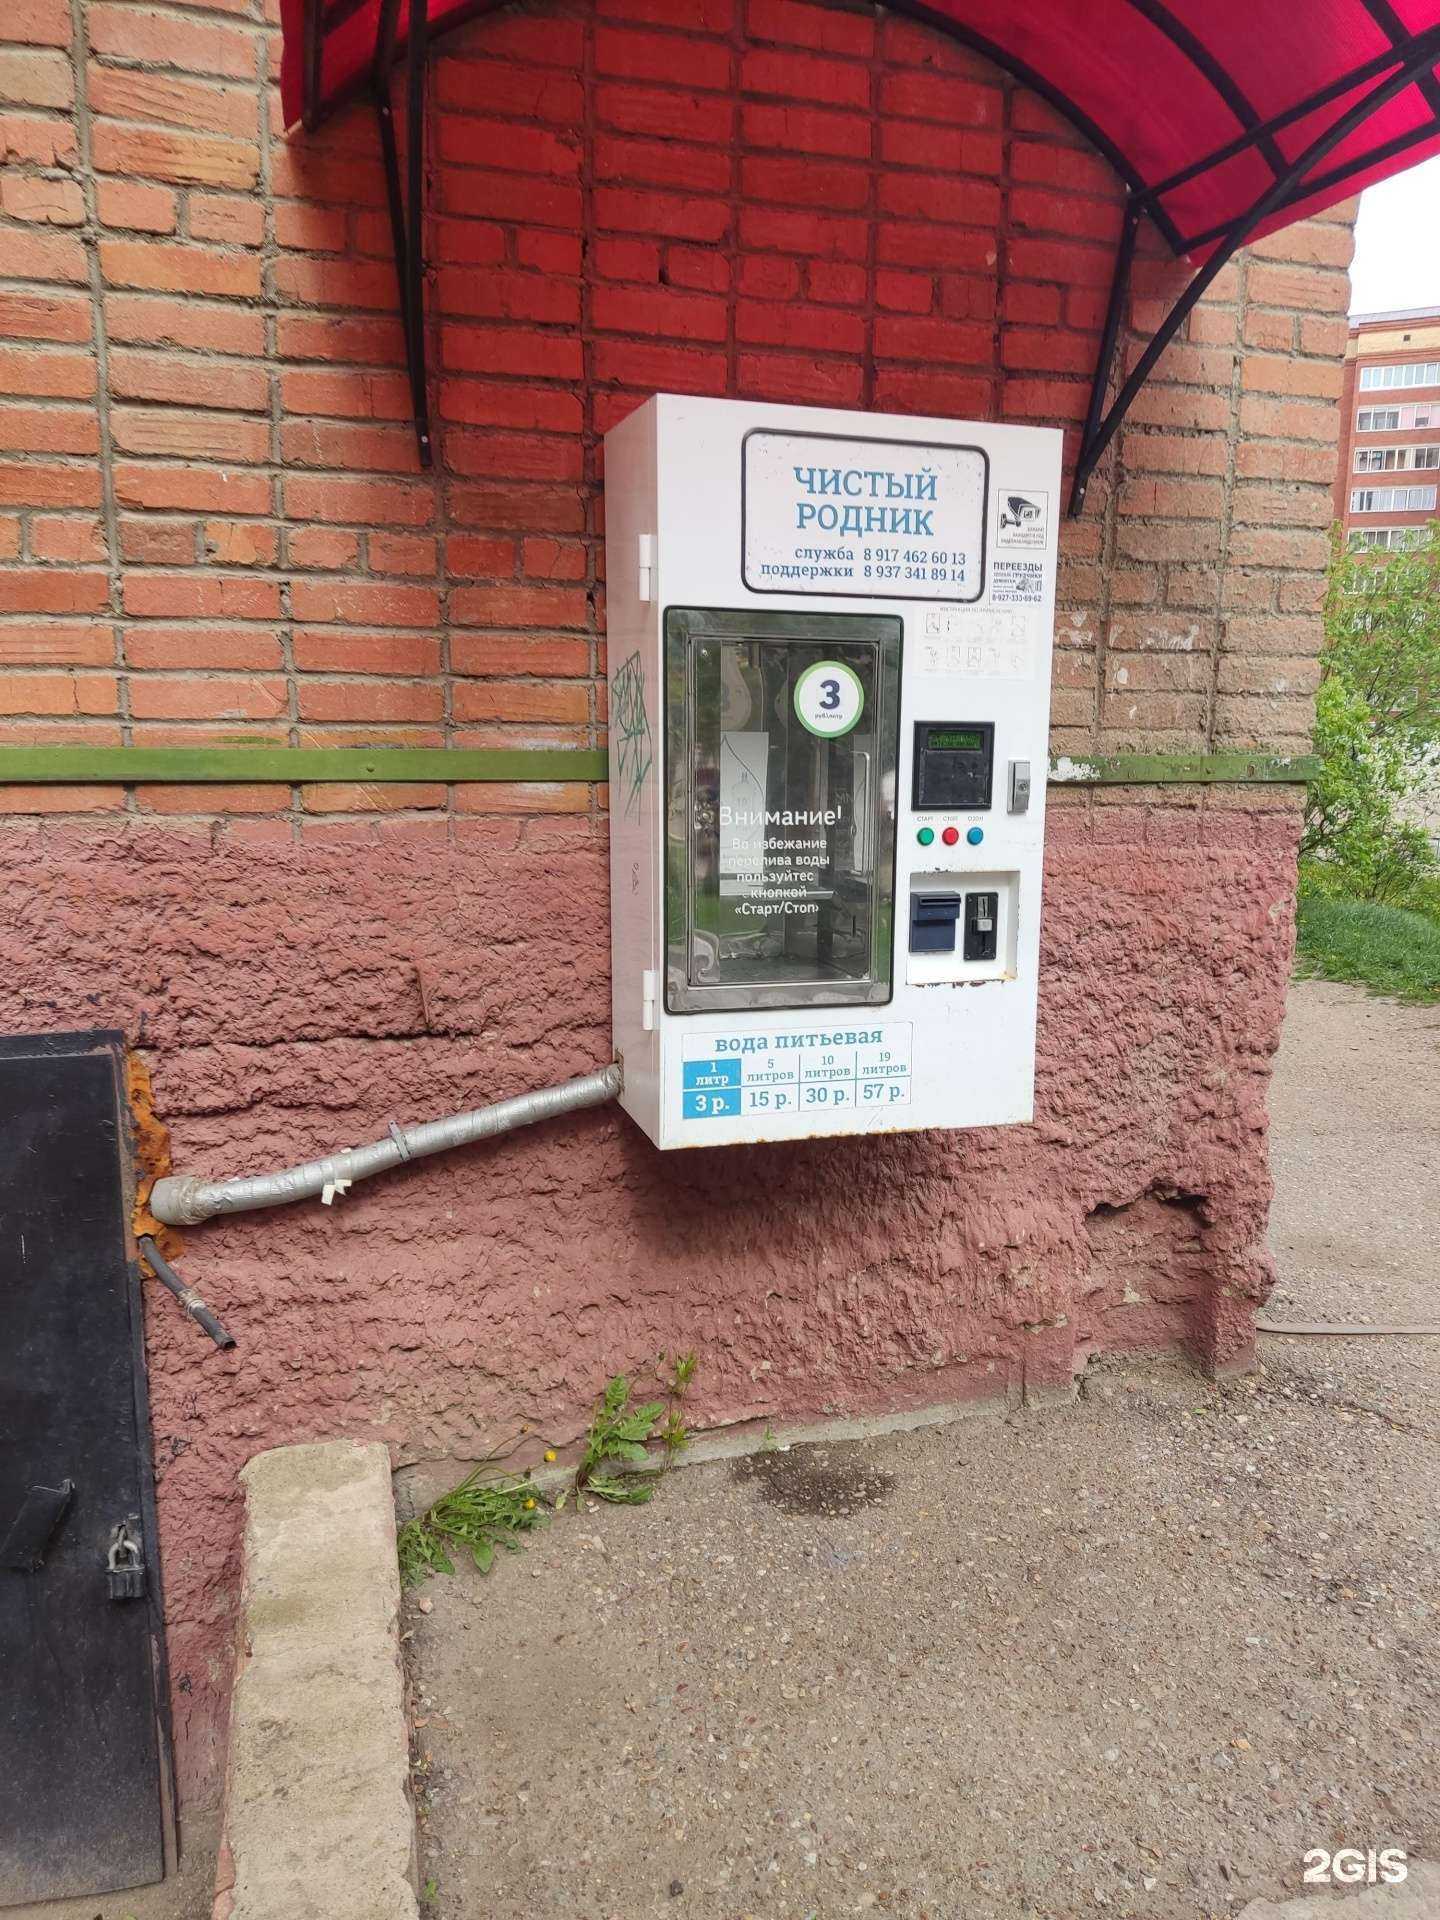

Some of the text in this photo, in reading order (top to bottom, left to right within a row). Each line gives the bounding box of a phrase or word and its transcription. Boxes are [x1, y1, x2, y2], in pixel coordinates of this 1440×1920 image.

[793, 466, 938, 501] ЧИСТЫЙ
[796, 502, 935, 538] РОДНИК
[794, 546, 966, 565] служба 8 917 462 60 13
[761, 563, 966, 582] поддержки 8 937 341 89 14
[993, 561, 1043, 573] ПЕРЕЕЗДЫ
[819, 679, 841, 710] 3
[720, 804, 842, 826] Внимание!
[753, 837, 828, 850] избежание
[795, 855, 830, 868] воды
[750, 885, 808, 899] кнопкой
[714, 1029, 884, 1055] вода питьевая
[767, 1058, 775, 1069] 5
[821, 1055, 835, 1066] 10
[878, 1052, 892, 1062] 19
[709, 1061, 718, 1073] 1
[804, 1067, 852, 1080] литров
[861, 1063, 907, 1076] литров
[695, 1074, 730, 1087] литр
[746, 1071, 795, 1083] литров
[805, 1087, 850, 1107] 30 р.
[862, 1083, 905, 1102] 57 р.
[695, 1094, 730, 1116] 3 р.
[749, 1090, 793, 1110] 15 р.
